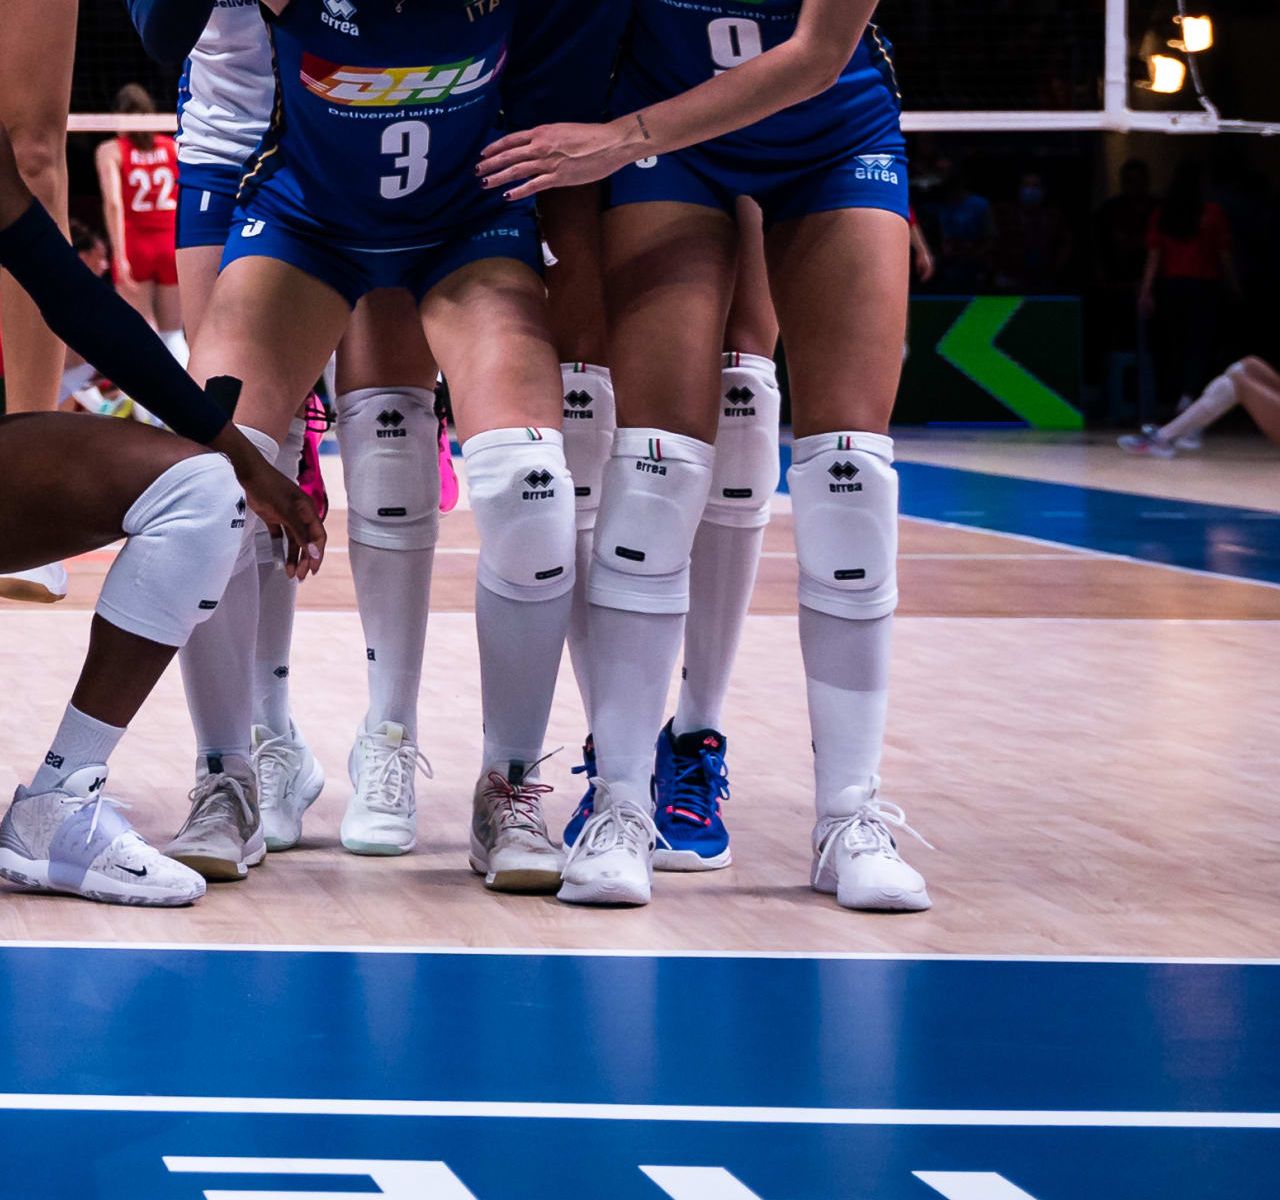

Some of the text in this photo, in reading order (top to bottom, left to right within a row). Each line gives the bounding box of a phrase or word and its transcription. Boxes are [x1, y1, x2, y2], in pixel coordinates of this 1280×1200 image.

[320, 11, 360, 37] errea
[326, 57, 496, 101] DHL
[328, 105, 445, 119] Delivered with
[379, 120, 431, 200] 3
[854, 166, 899, 186] errea
[128, 166, 177, 212] 22
[563, 409, 593, 420] errea
[723, 406, 756, 418] errea
[376, 427, 407, 438] errea
[635, 459, 668, 477] errea
[521, 489, 555, 501] errea
[829, 482, 863, 493] errea
